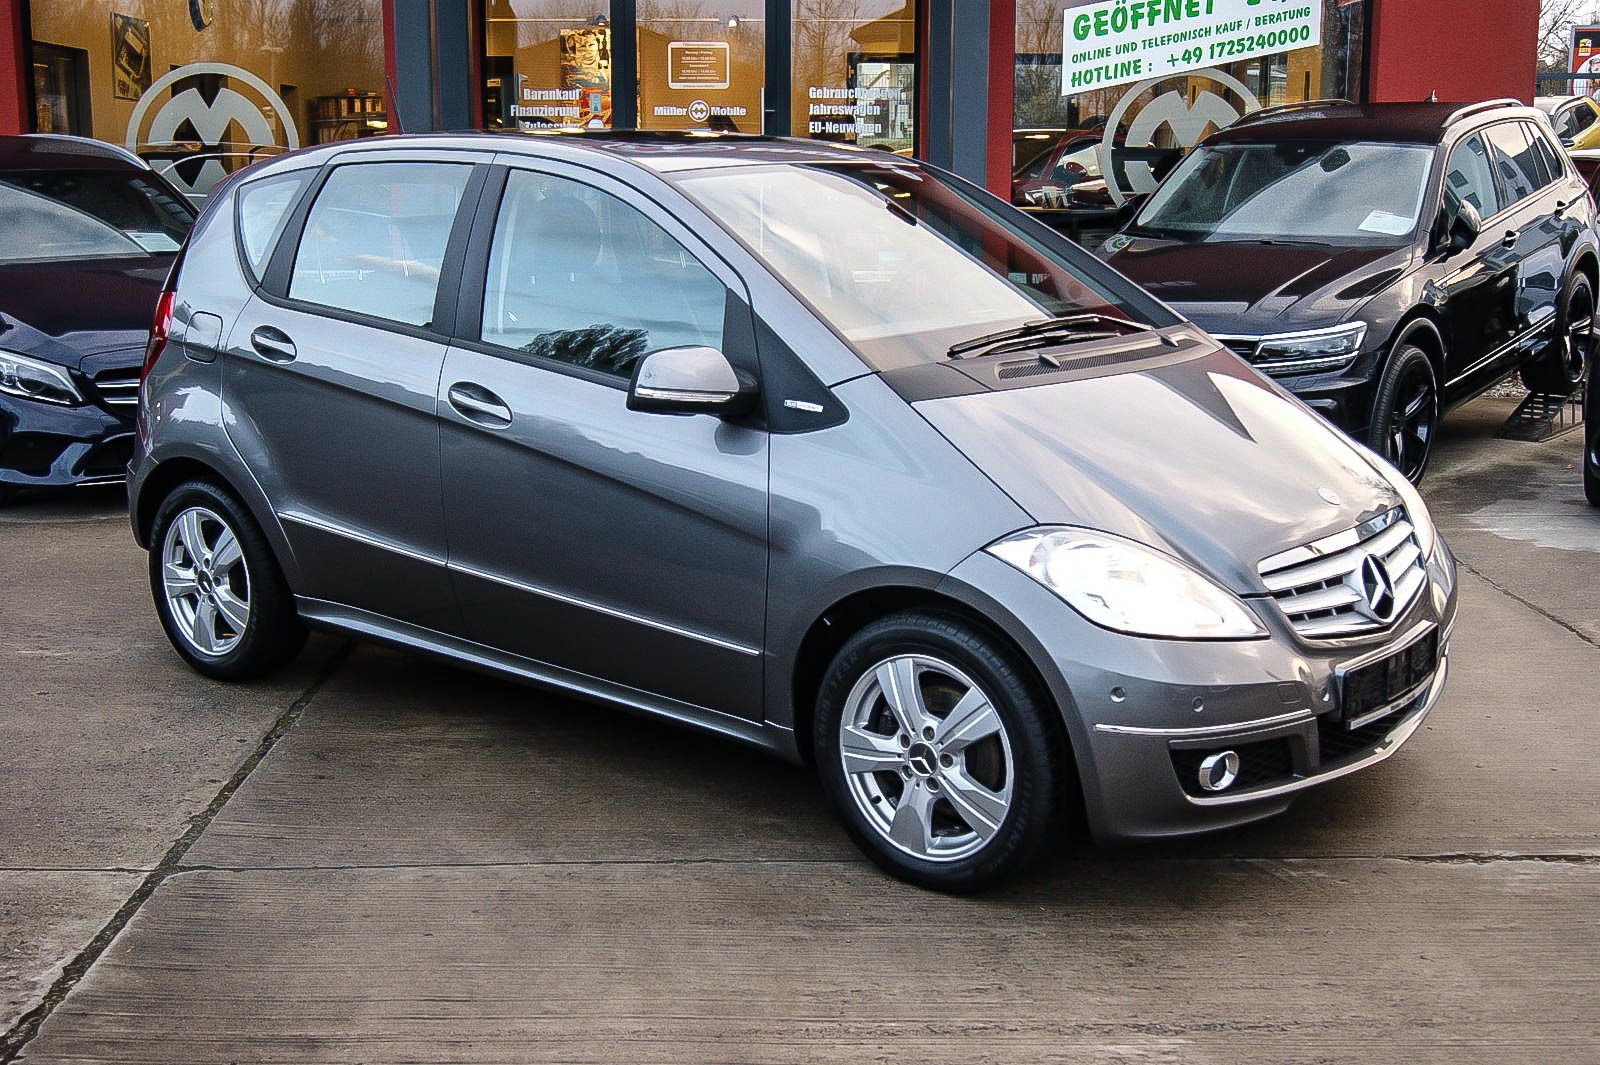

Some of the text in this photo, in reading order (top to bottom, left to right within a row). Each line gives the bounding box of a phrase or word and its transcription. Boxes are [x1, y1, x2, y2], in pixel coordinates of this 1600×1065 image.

[1071, 46, 1112, 64] ONLINE
[1115, 42, 1138, 55] UND
[1141, 26, 1212, 50] TELEFONISCH
[1215, 20, 1242, 35] KAUF
[1254, 6, 1311, 27] BERATUNG
[1071, 58, 1142, 88] HOTLINE
[1166, 46, 1203, 67] +49
[1209, 25, 1310, 60] 1725240000
[523, 88, 582, 100] Barankauf
[510, 104, 580, 117] Finanzierung
[653, 106, 747, 116] Müller Mobile
[808, 103, 881, 116] Jahreswagen
[808, 121, 882, 133] EU-Neuwagen
